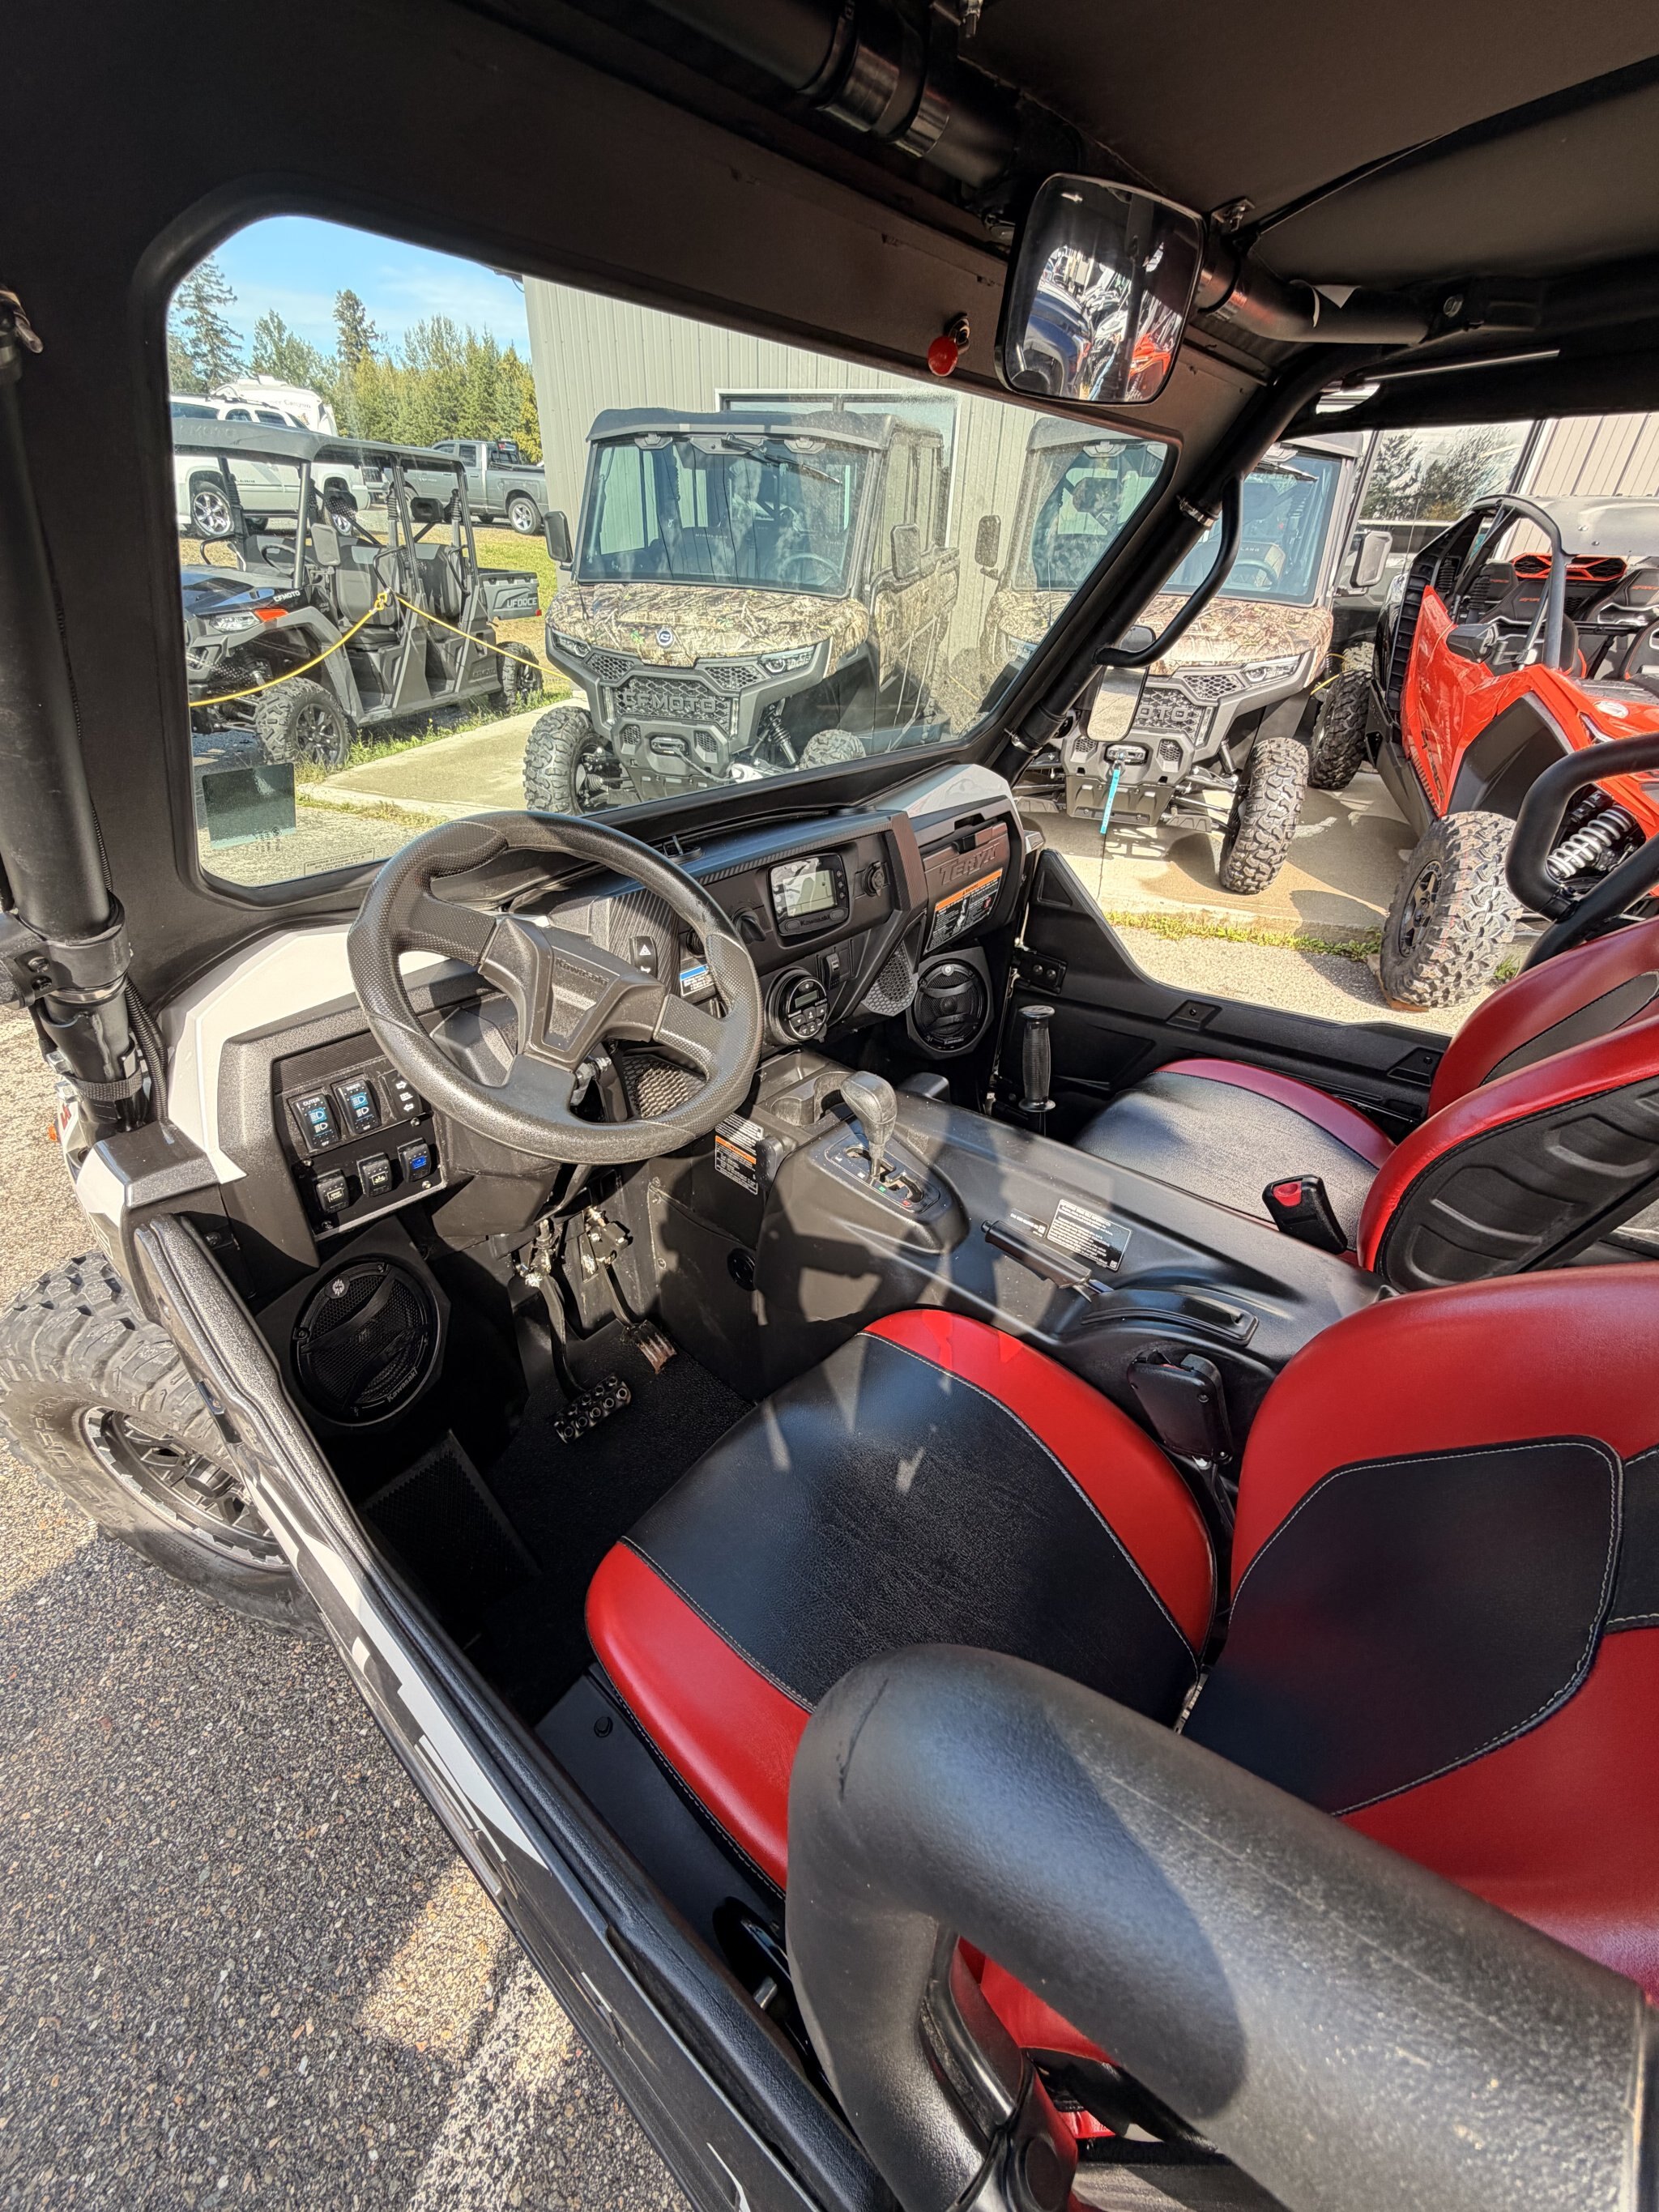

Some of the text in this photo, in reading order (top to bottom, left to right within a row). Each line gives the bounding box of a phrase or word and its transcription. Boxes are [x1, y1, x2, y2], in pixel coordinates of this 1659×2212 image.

[273, 590, 301, 602] CFMOTO
[506, 597, 538, 608] UFORCE
[622, 691, 716, 714] CFMOTO
[1136, 704, 1188, 722] OTO
[555, 957, 610, 986] Kawasaki
[302, 1097, 321, 1106] OUTER
[386, 1366, 418, 1402] Kawasaki
